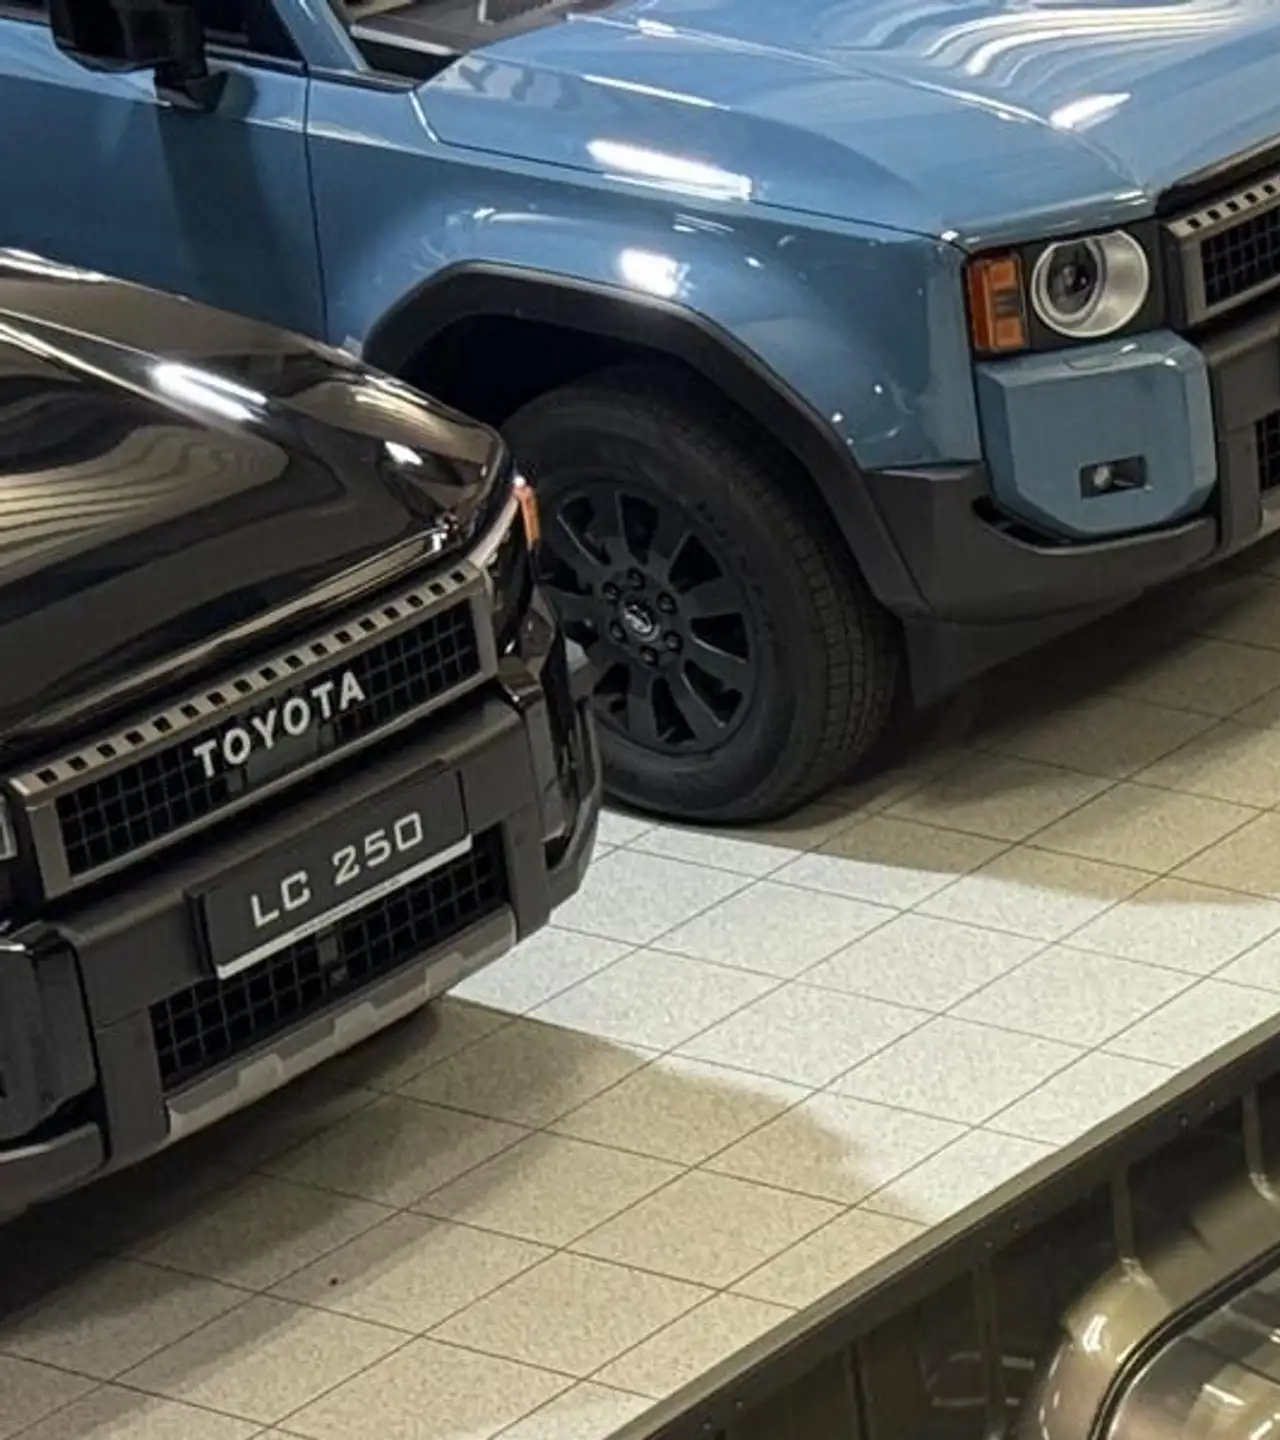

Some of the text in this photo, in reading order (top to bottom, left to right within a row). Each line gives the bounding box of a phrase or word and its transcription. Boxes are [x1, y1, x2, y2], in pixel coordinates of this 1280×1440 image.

[192, 671, 366, 778] TOYOTA
[251, 870, 311, 928] LC
[332, 811, 423, 887] 250
